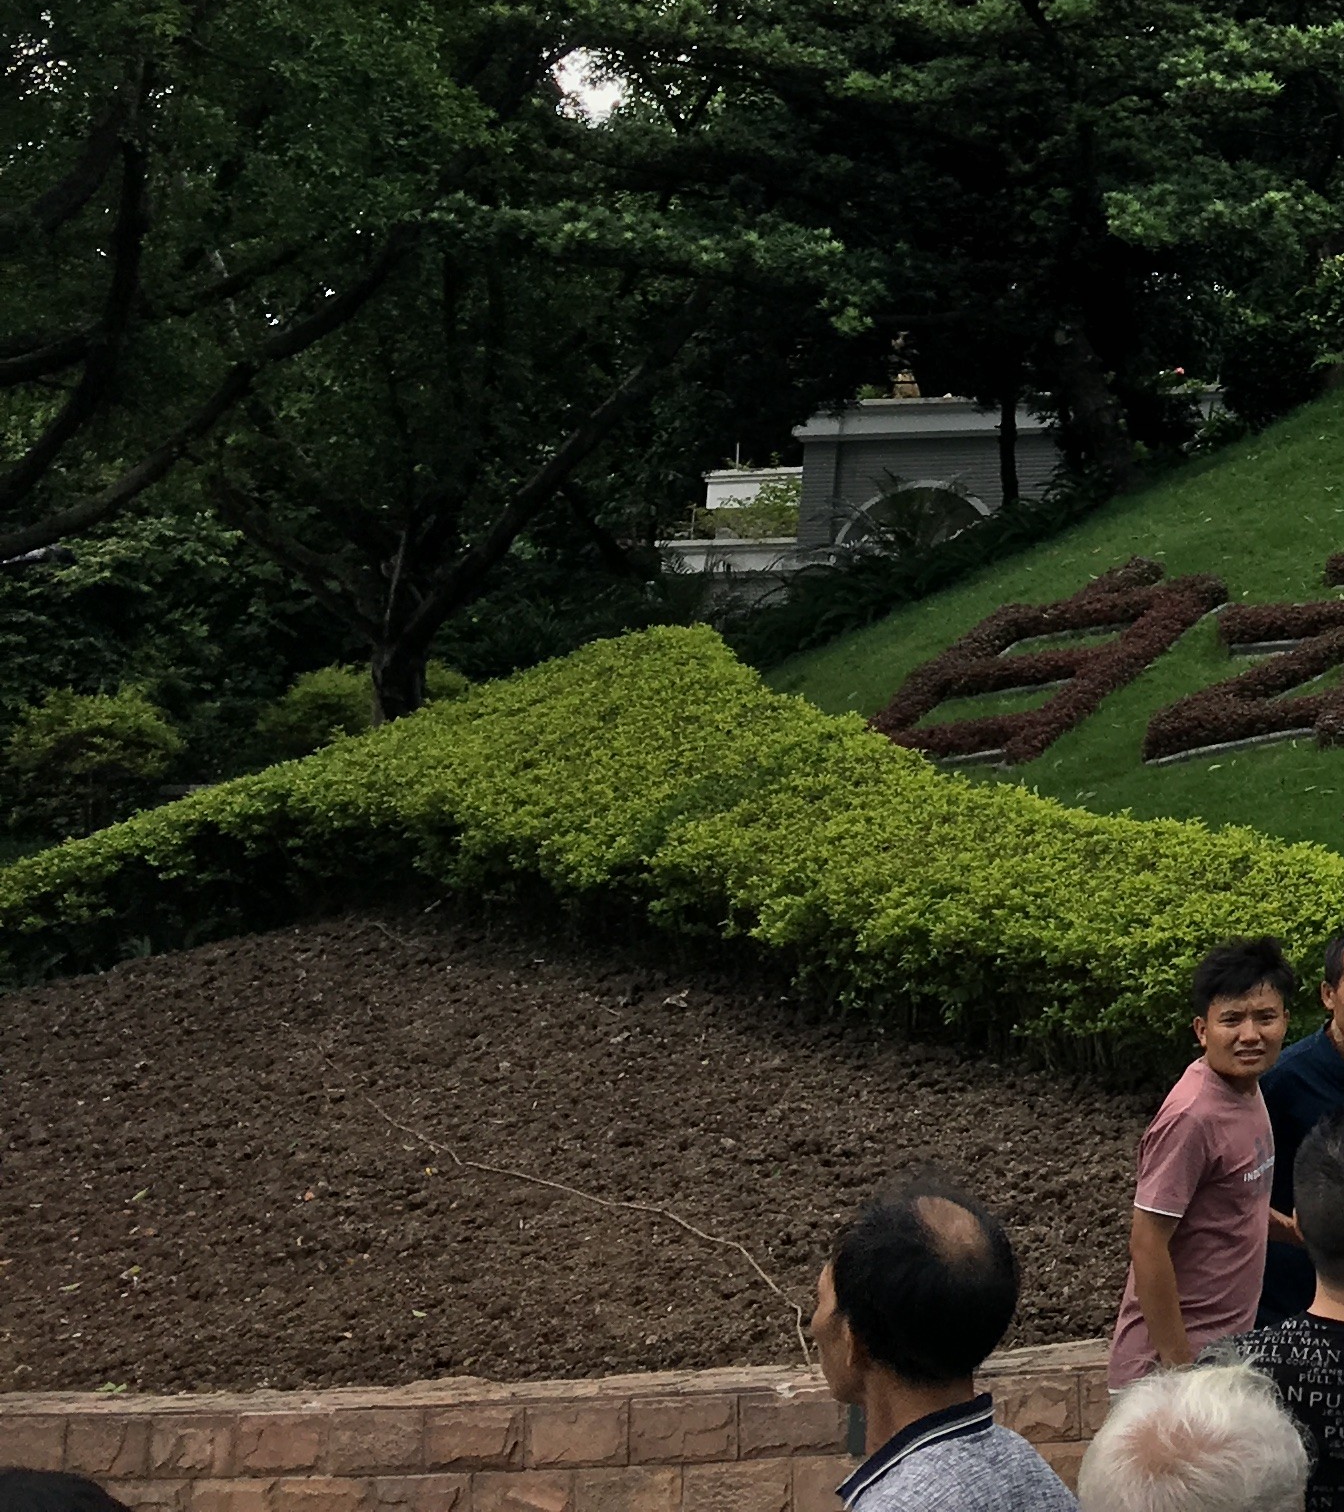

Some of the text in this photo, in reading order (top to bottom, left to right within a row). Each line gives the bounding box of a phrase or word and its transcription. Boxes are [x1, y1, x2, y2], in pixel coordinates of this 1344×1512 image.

[1263, 1336, 1294, 1346] PULL
[1299, 1337, 1331, 1347] MAN
[1290, 1347, 1341, 1363] MAN
[1299, 1373, 1332, 1385] PULL
